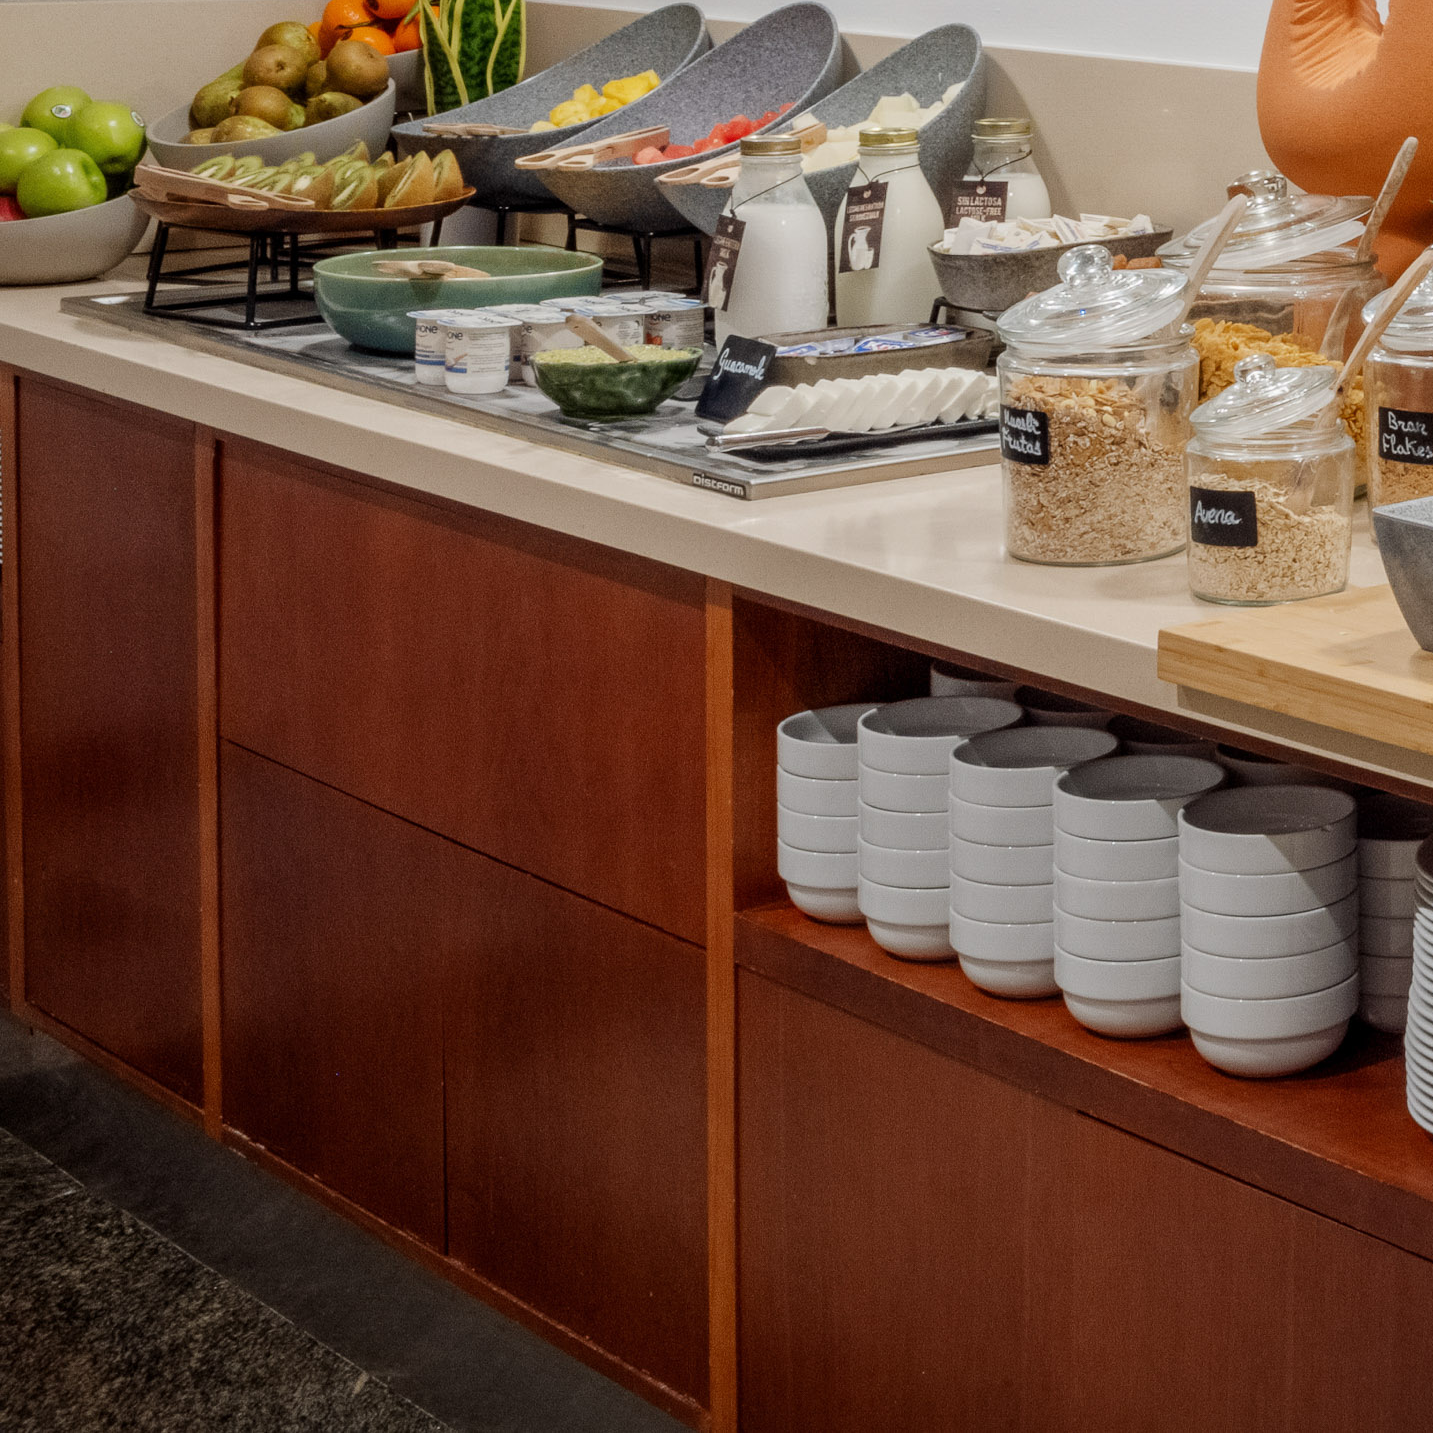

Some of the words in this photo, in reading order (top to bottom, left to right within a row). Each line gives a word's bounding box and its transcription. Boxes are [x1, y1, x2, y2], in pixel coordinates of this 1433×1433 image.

[970, 196, 1002, 207] LACTOSA
[955, 206, 1002, 216] LACTOSE-FREE
[1194, 500, 1242, 525] Avena
